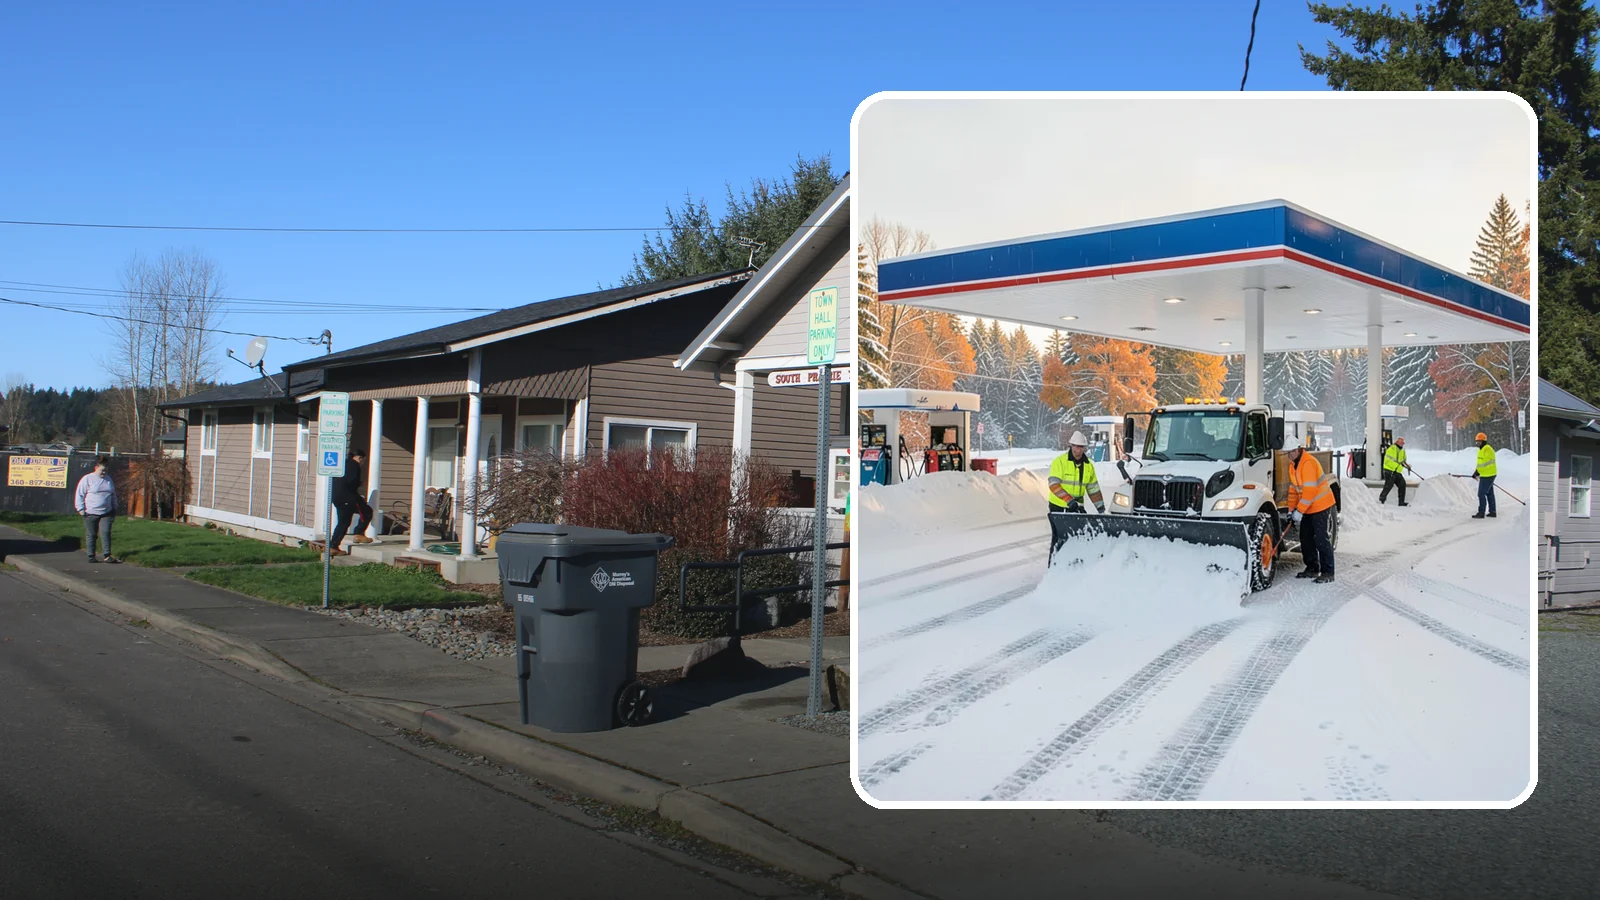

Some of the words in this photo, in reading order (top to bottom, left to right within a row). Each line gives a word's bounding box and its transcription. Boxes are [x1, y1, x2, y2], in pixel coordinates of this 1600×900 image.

[815, 294, 833, 308] TOWN
[815, 312, 831, 324] HALL
[810, 327, 835, 340] PARKING
[814, 344, 830, 357] ONLY
[776, 373, 801, 384] SOUTH
